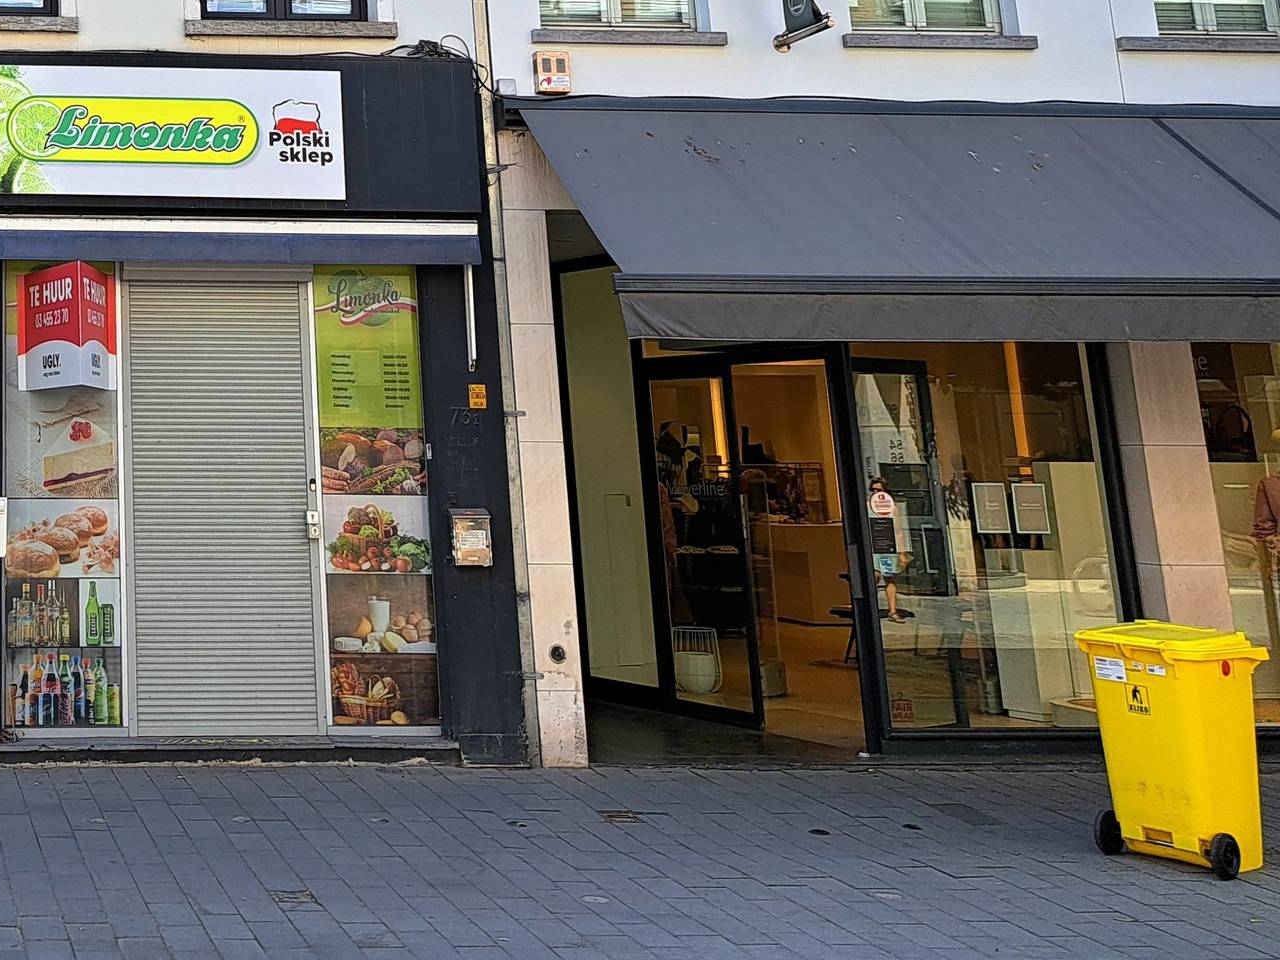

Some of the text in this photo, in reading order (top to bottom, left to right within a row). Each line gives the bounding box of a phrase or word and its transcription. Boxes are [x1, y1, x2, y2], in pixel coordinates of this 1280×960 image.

[45, 105, 245, 152] Limonka
[269, 130, 331, 149] Polski
[278, 148, 334, 166] sklep
[29, 277, 73, 308] TE HUUR
[328, 279, 402, 314] Limonka
[666, 479, 725, 496] Myerline
